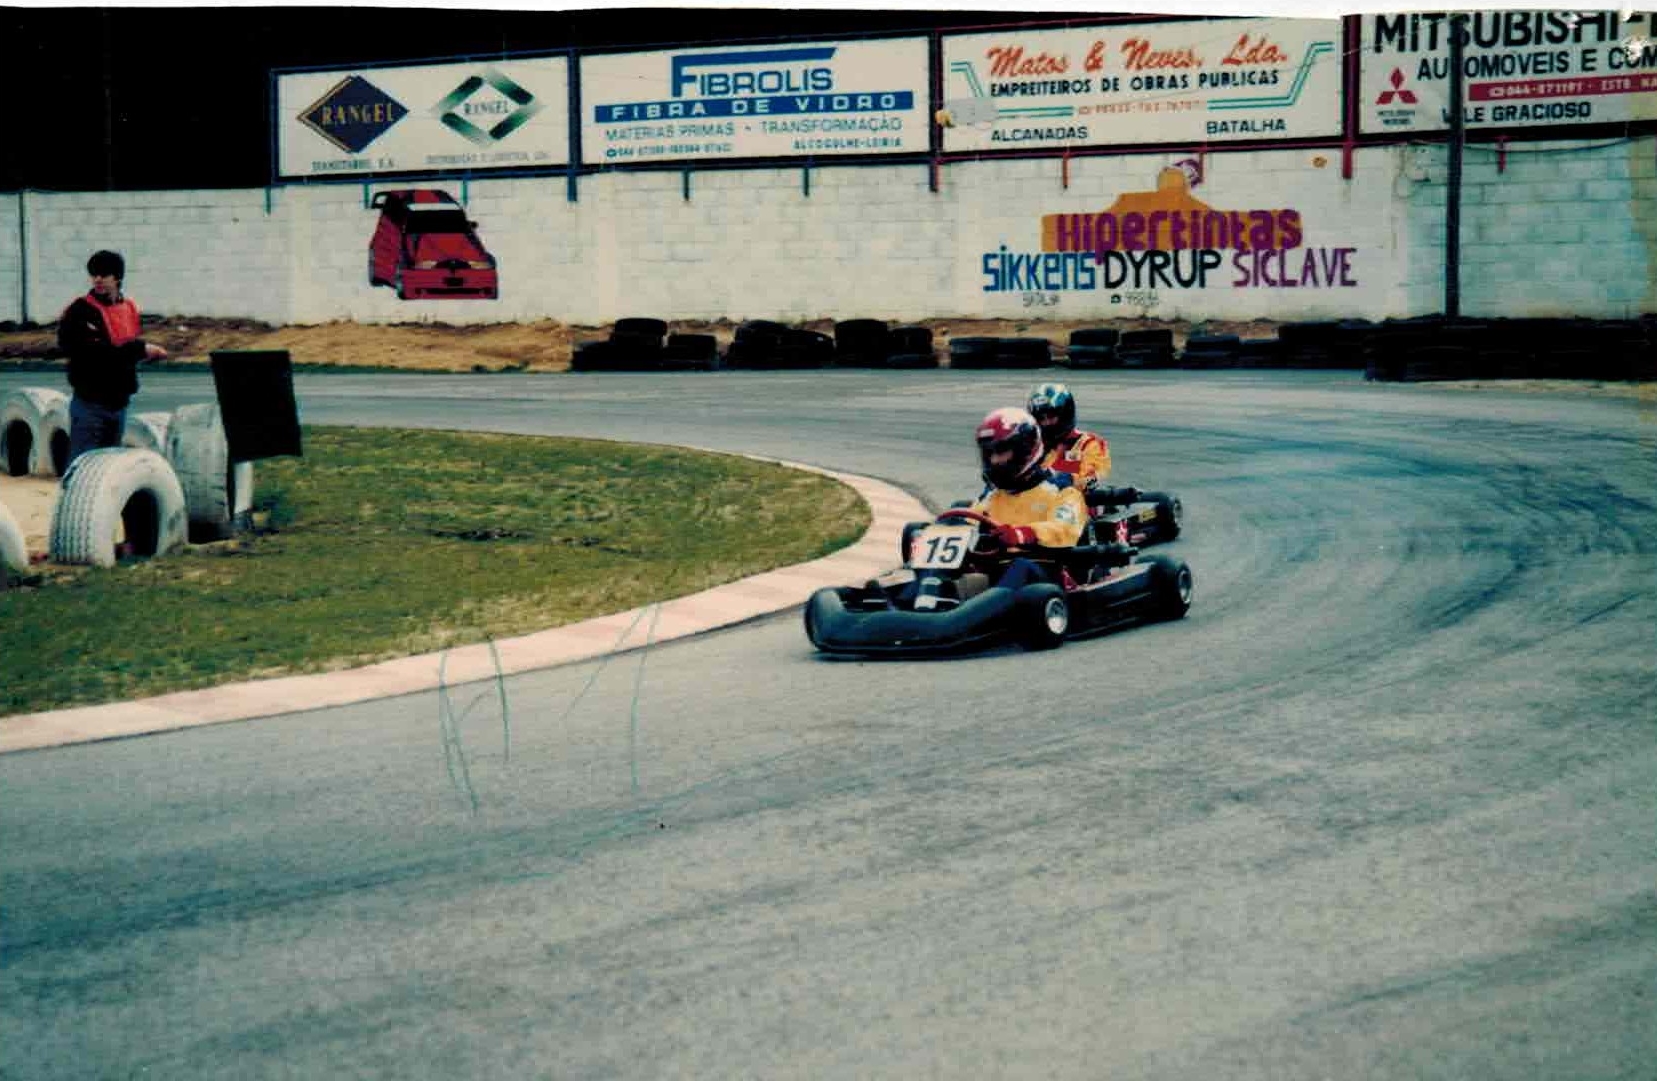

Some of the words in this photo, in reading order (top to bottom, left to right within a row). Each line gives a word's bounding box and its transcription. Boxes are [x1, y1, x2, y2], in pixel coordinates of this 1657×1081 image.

[986, 45, 1070, 77] Matos
[1084, 40, 1105, 72] &
[1221, 34, 1288, 65] Lda.
[1417, 51, 1570, 81] AUOMOVEIS
[1581, 49, 1597, 71] E
[671, 47, 837, 97] FIBROLIS
[991, 79, 1092, 97] EMPREITEIROS
[1101, 77, 1120, 92] DE
[1130, 73, 1189, 91] OBRAS
[1199, 69, 1279, 88] PUBLICAS
[320, 103, 394, 126] RANGEL
[611, 102, 707, 120] FIBRA
[732, 99, 771, 114] DE
[795, 94, 896, 111] VIDRO
[1492, 101, 1592, 122] GRACIOSO
[991, 126, 1088, 142] ALCANADAS
[1206, 118, 1286, 134] BATALHA
[1104, 249, 1222, 289] DYRUP
[1233, 247, 1358, 288] SICLAVE
[926, 536, 963, 564] 15
